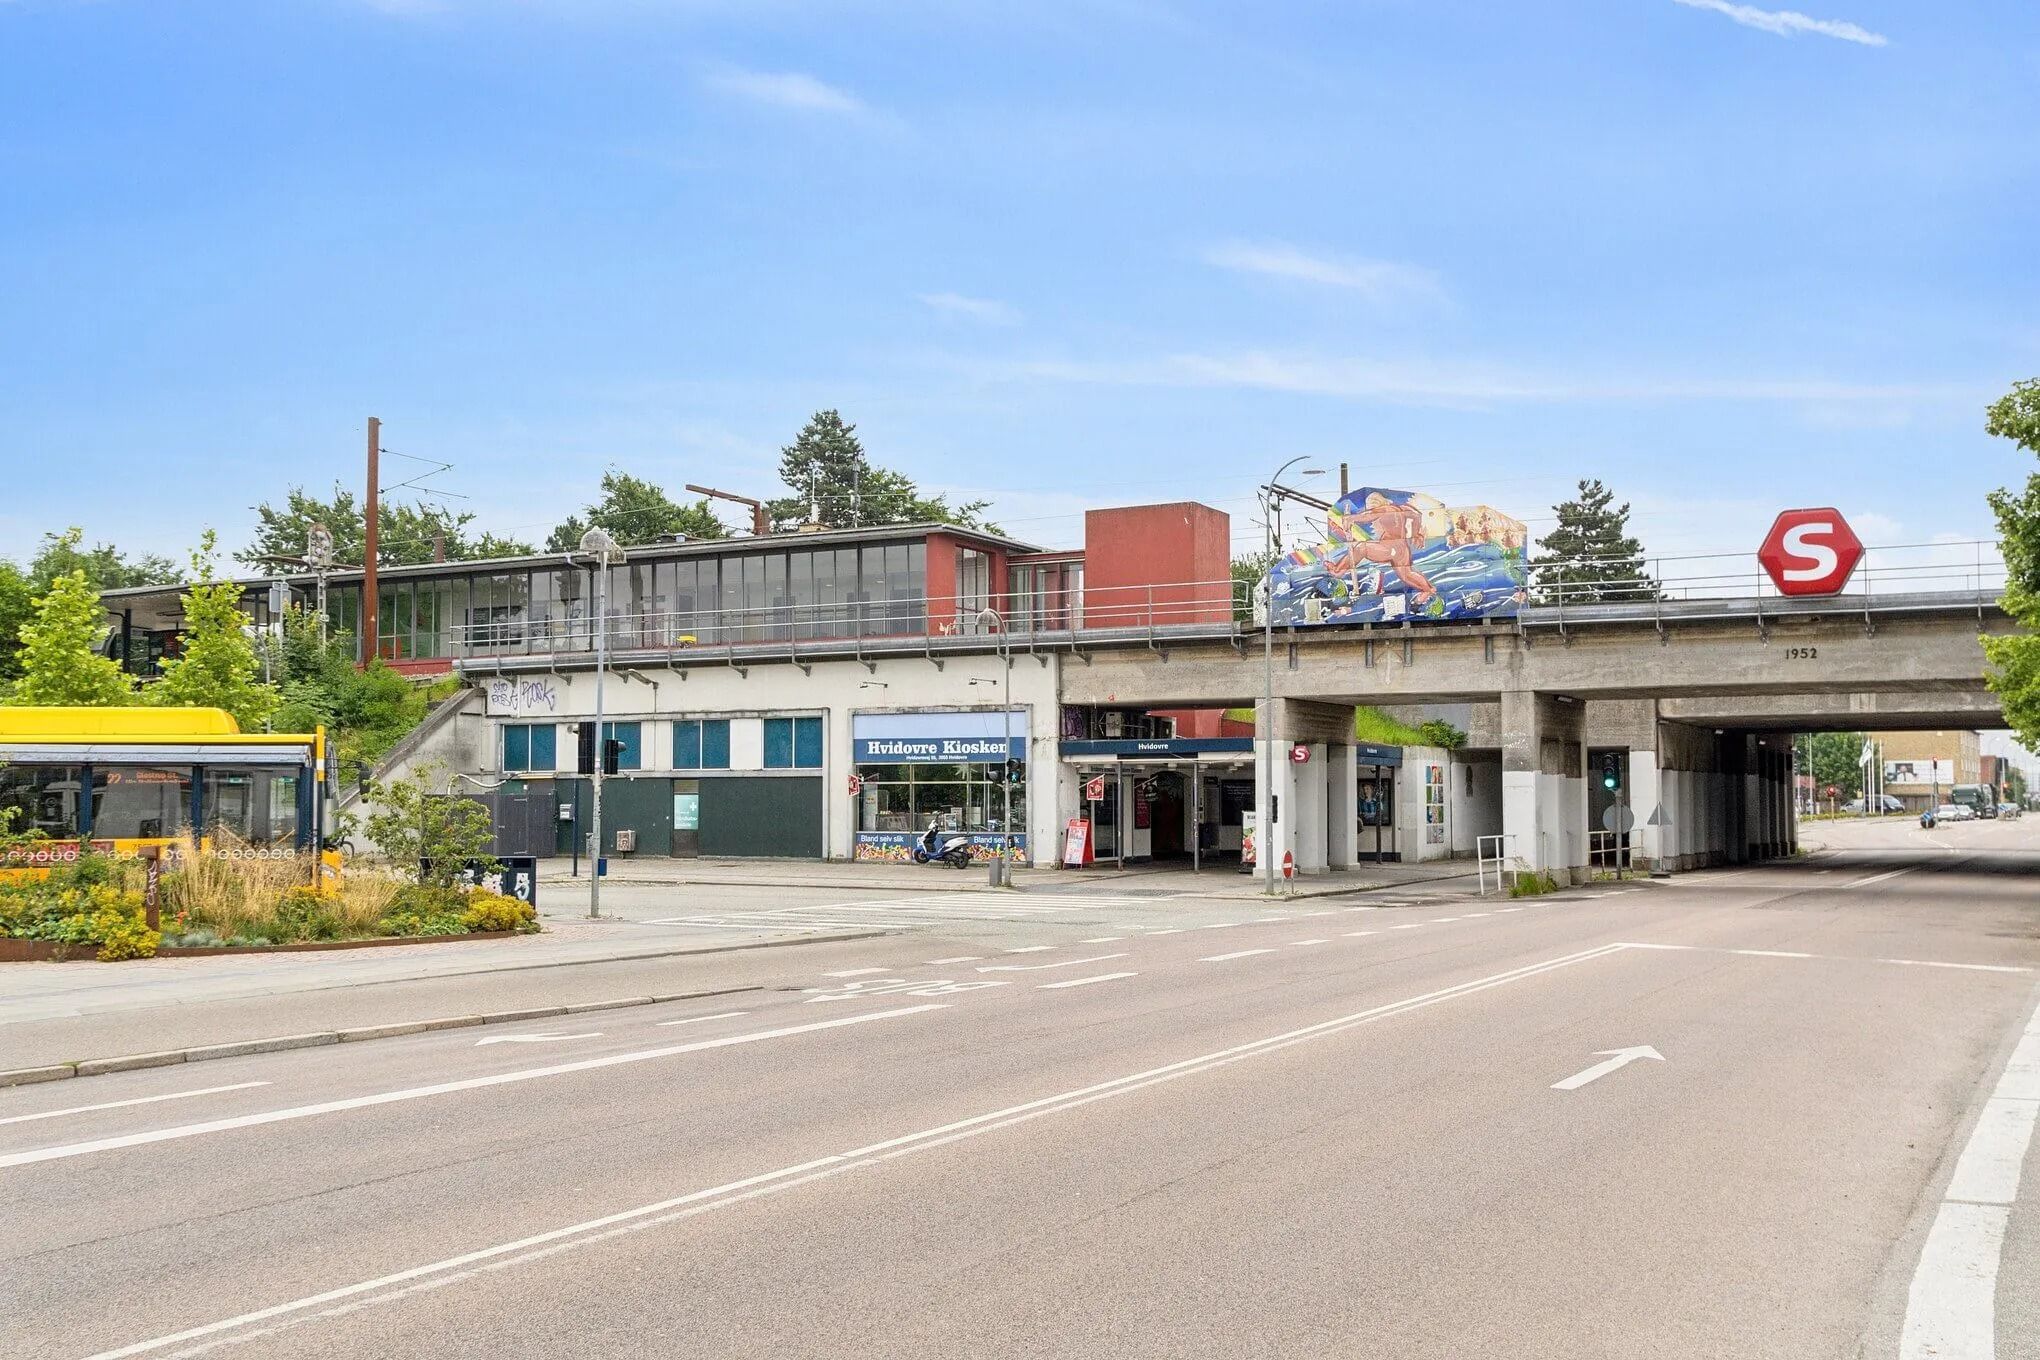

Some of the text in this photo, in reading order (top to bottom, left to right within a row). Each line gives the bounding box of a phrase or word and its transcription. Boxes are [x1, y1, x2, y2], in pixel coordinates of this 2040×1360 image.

[1782, 522, 1838, 581] S
[1785, 648, 1818, 660] 1952
[867, 740, 1007, 755] Hvidovre Kiosken
[1294, 748, 1306, 760] S
[860, 834, 904, 843] Bland selv slik
[973, 835, 993, 844] Bland
